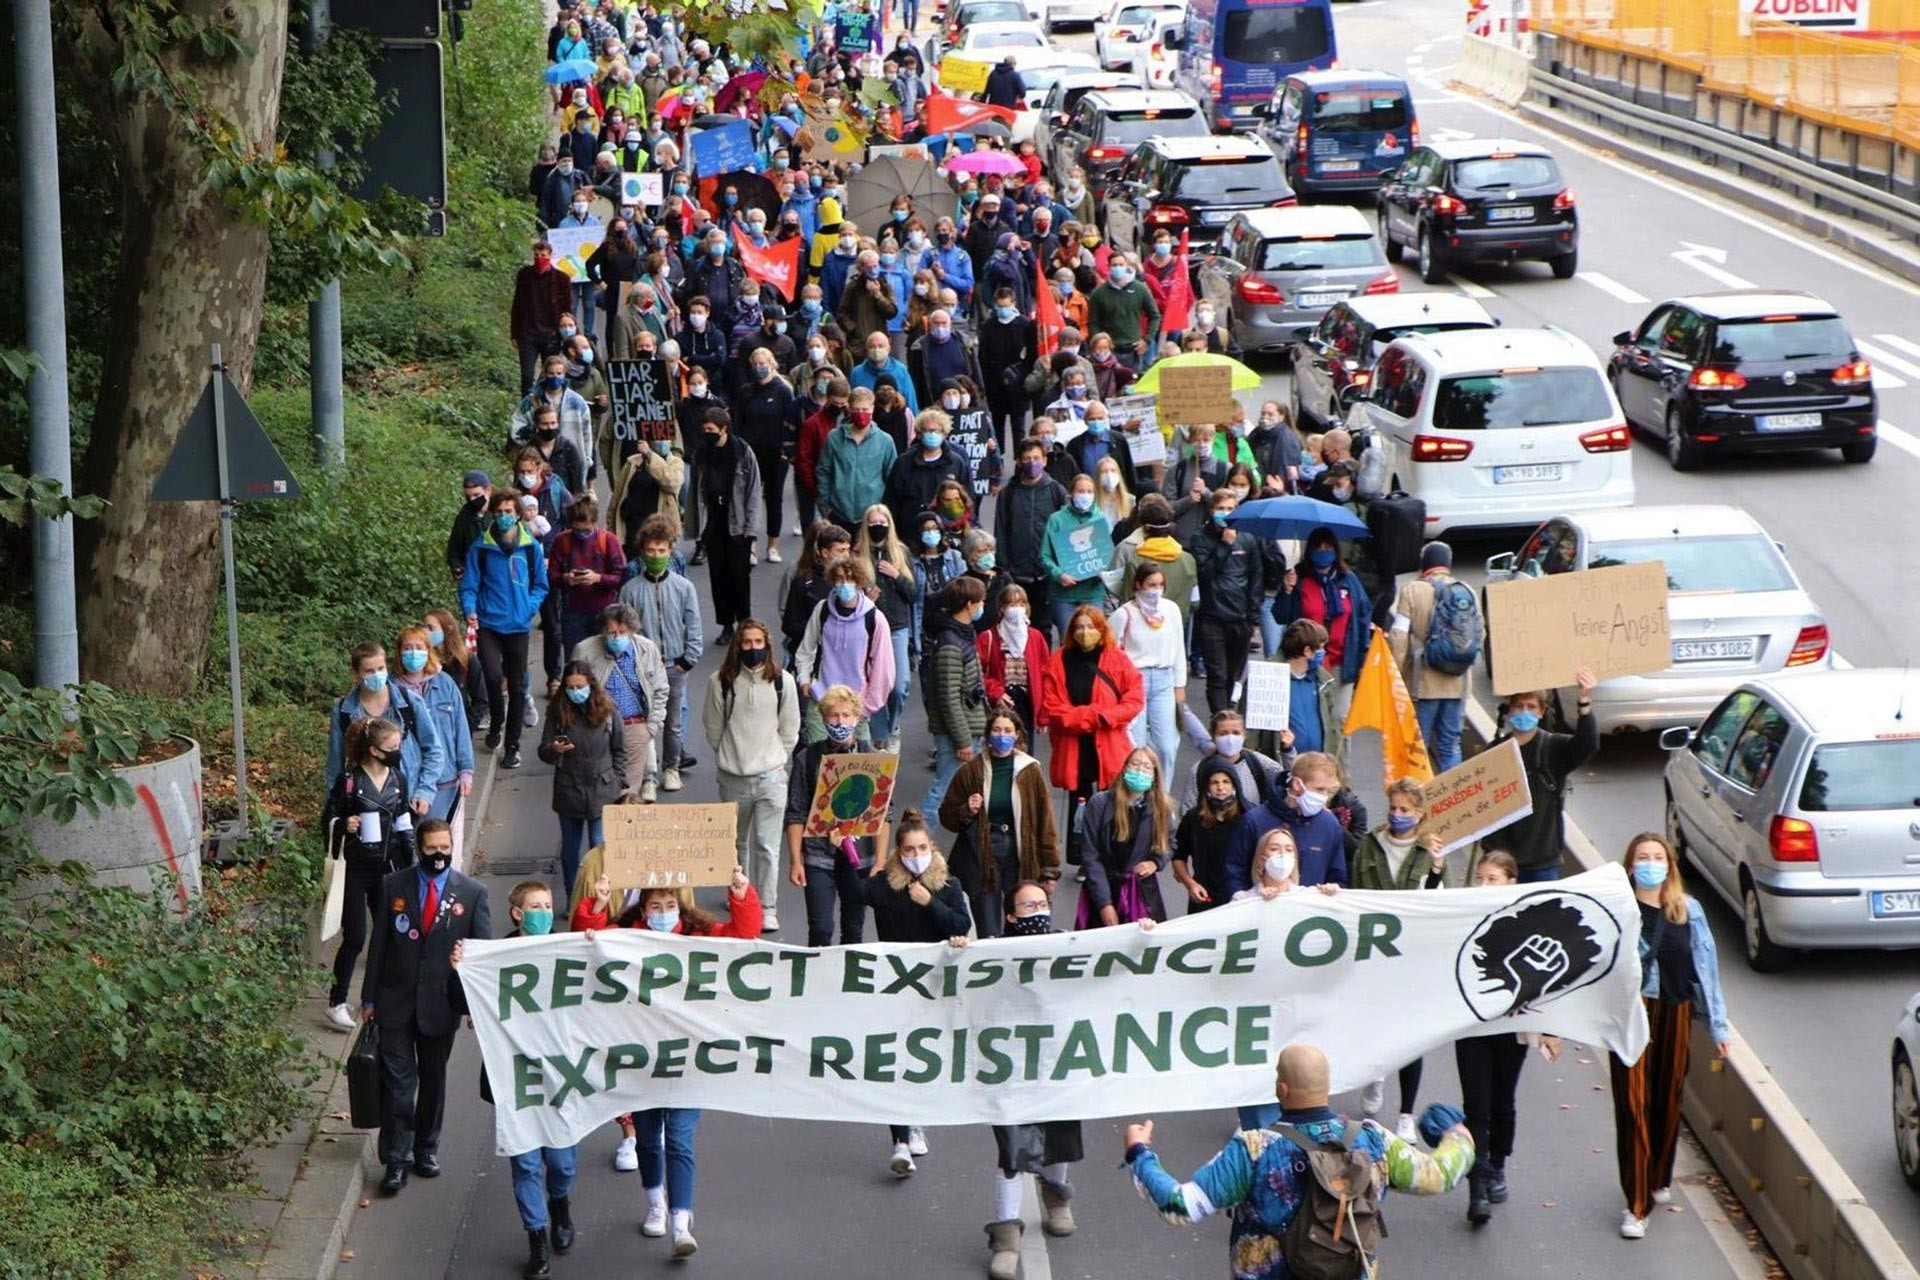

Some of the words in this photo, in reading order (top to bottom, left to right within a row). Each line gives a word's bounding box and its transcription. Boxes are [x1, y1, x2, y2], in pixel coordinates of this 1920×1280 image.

[614, 401, 673, 422] PLANET
[960, 411, 985, 430] PART
[614, 420, 638, 440] ON
[641, 421, 675, 440] FIRE
[963, 432, 978, 443] THE
[1077, 558, 1107, 575] COOL
[1572, 611, 1608, 637] keine
[1609, 601, 1668, 647] Angst
[1431, 781, 1483, 817] AUSREDEN
[1494, 780, 1519, 804] ZEIT
[637, 808, 658, 822] bist
[614, 844, 627, 859] du
[635, 844, 662, 860] bist
[667, 842, 714, 860] einfach
[645, 859, 686, 872] KEINE
[1884, 895, 1895, 910] S
[1906, 895, 1920, 910] Y
[499, 950, 820, 1022] RESPECT
[841, 929, 1260, 1001] EXISTENCE
[1284, 912, 1403, 967] OR
[513, 1035, 785, 1111] EXPECT
[809, 1004, 1272, 1085] RESISTANCE
